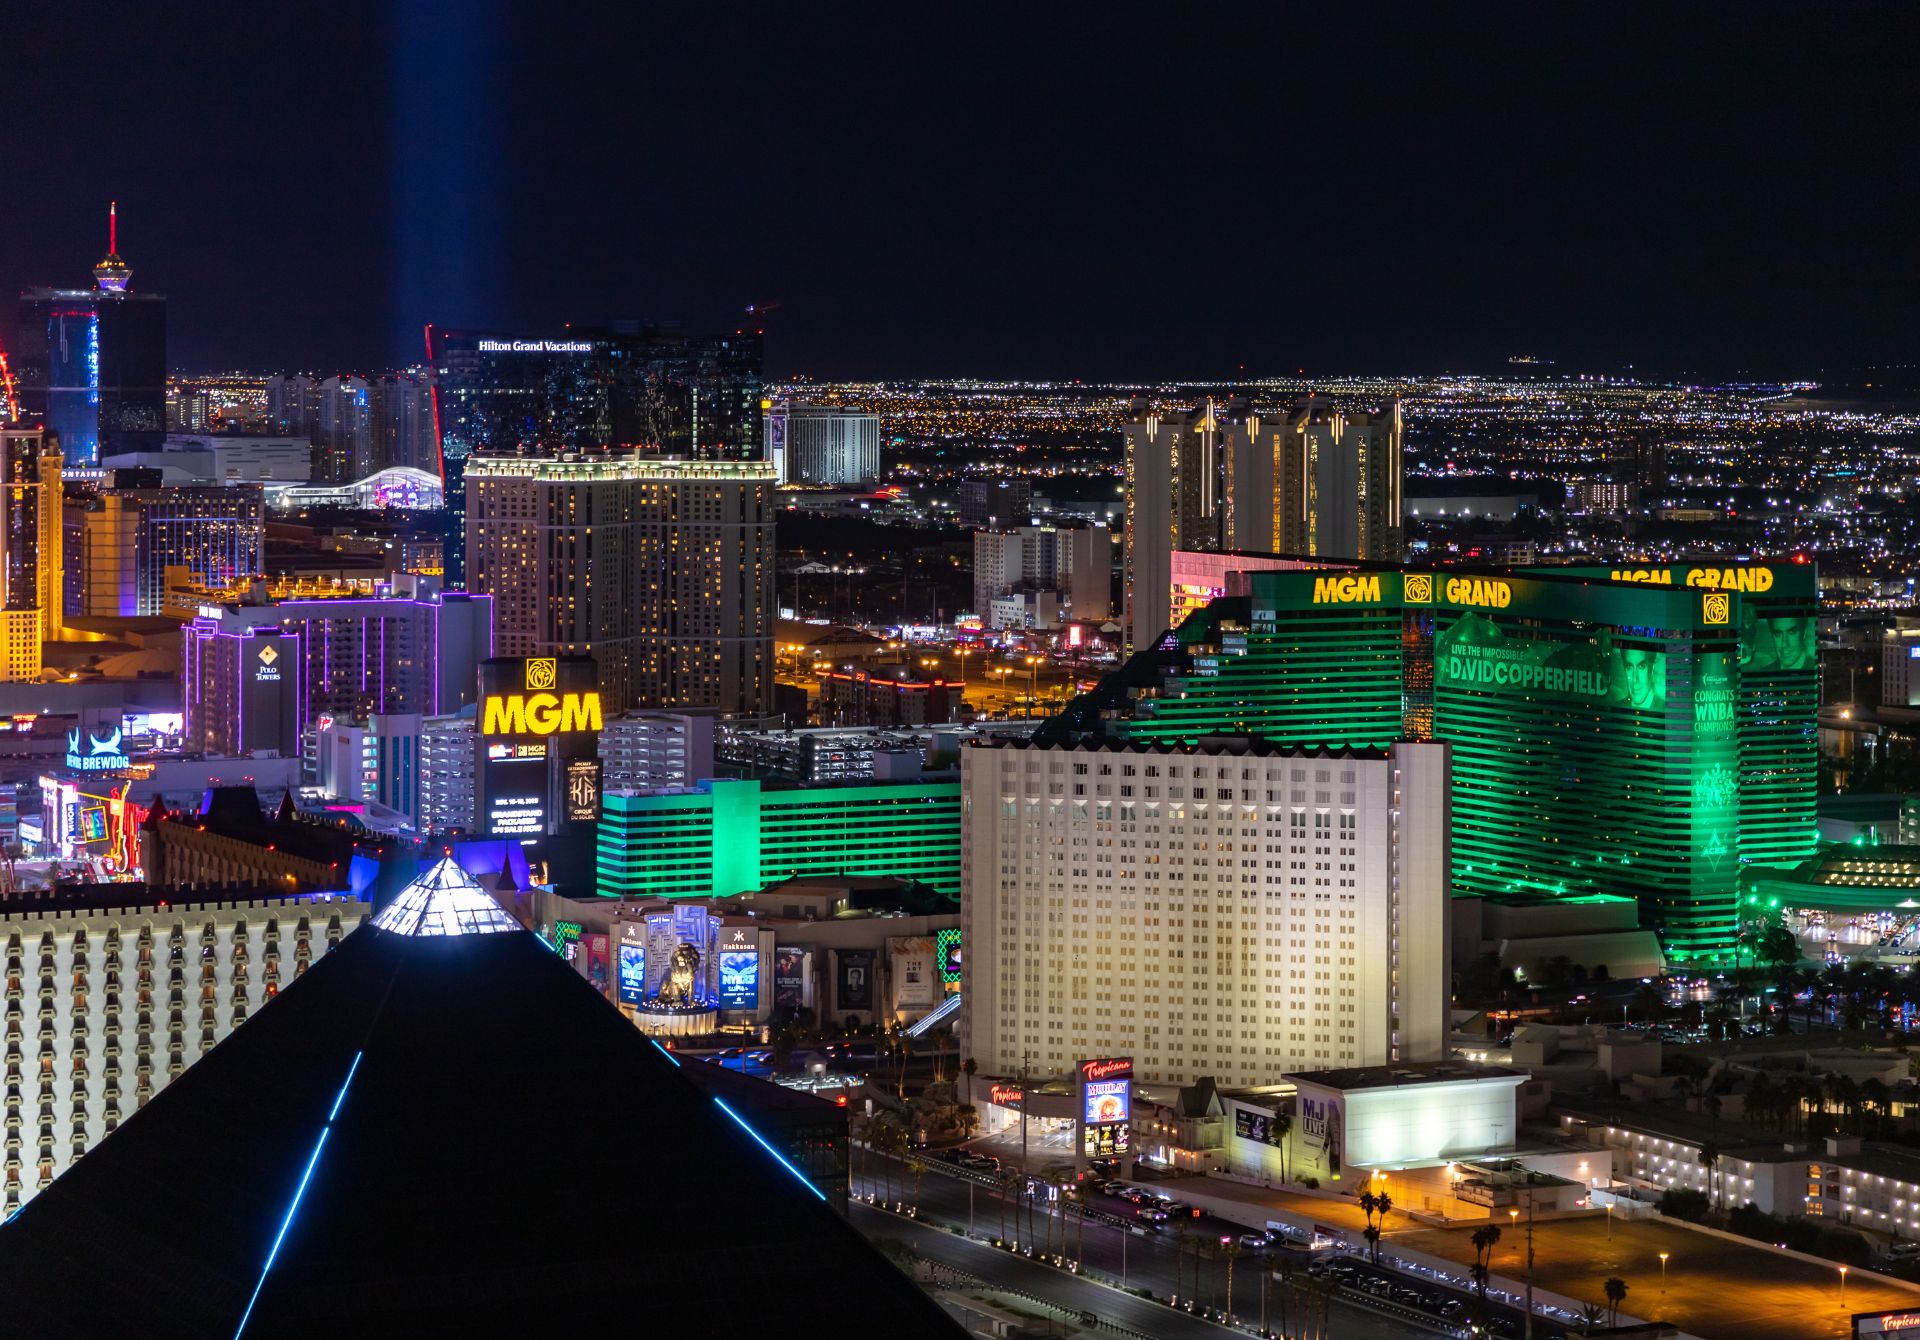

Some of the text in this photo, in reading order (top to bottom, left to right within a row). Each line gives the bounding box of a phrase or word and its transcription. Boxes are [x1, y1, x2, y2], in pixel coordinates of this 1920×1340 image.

[479, 340, 591, 351] Hilton Grand Vacations
[1686, 567, 1774, 592] GRAND
[1312, 576, 1511, 608] MGM GRAND
[1451, 643, 1526, 661] LIVE THE IMPOSSIBLE
[260, 666, 277, 674] POLO
[1694, 689, 1735, 702] CONGRATS
[483, 692, 603, 735] MGM
[1694, 702, 1735, 721] WNBA
[1694, 721, 1735, 732] CHAMPIONS!
[82, 755, 129, 769] BREWDOG
[1082, 1060, 1131, 1081] Tropicana
[991, 1084, 1022, 1104] Tropicana
[1303, 1098, 1325, 1120] MJ
[1303, 1117, 1325, 1137] LIVE
